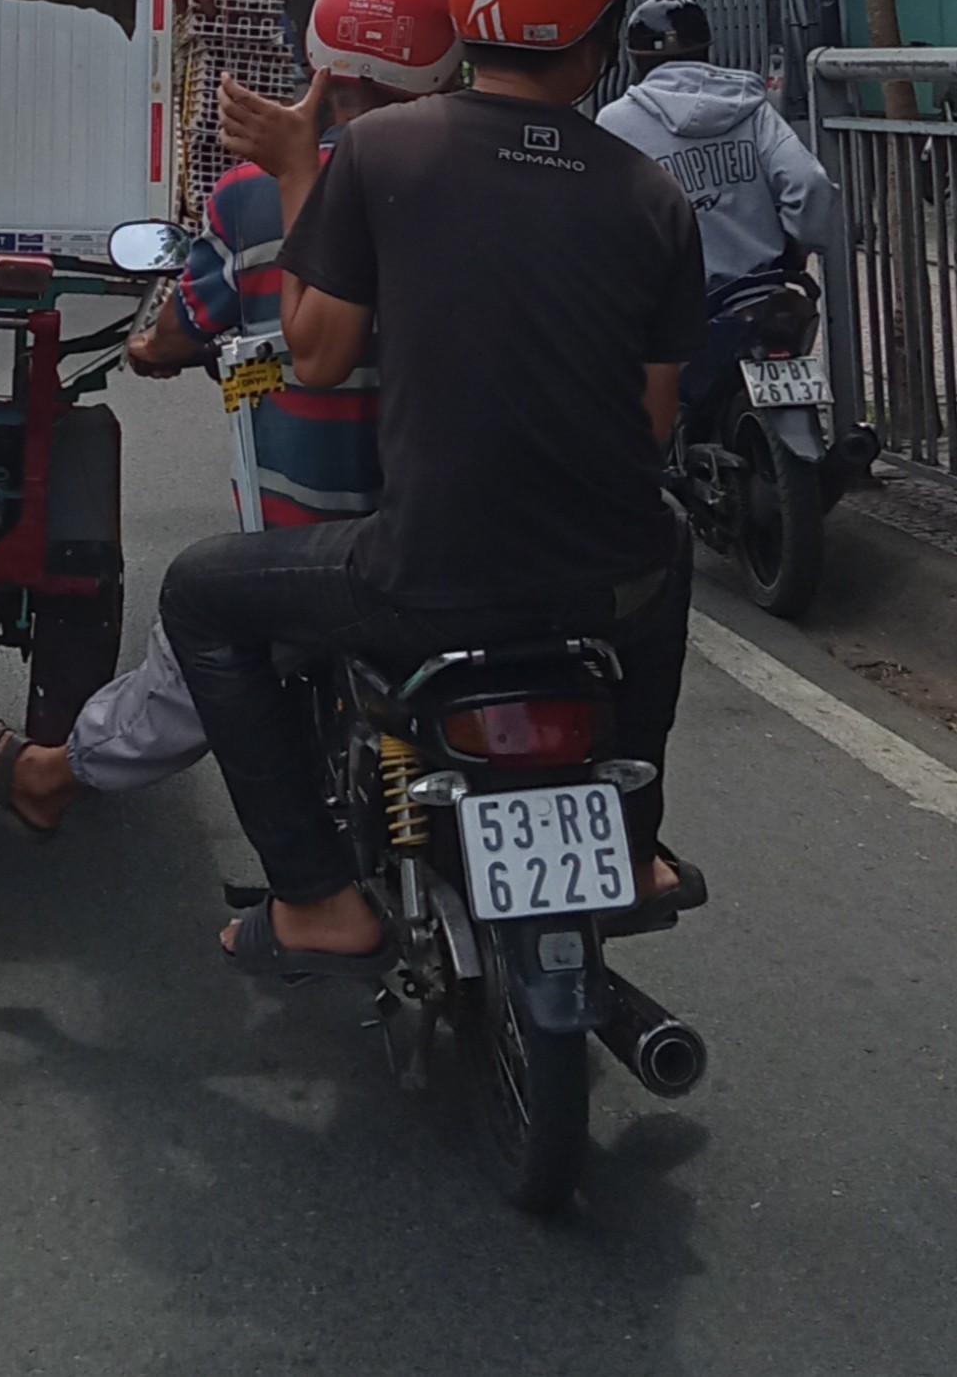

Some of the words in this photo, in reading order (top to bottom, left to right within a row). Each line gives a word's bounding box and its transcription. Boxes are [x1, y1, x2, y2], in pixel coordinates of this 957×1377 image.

[498, 147, 585, 172] ROMANO
[755, 361, 811, 381] 70-B1
[754, 381, 823, 403] 261.37
[478, 790, 612, 853] 53-R8
[487, 848, 622, 913] 6225
